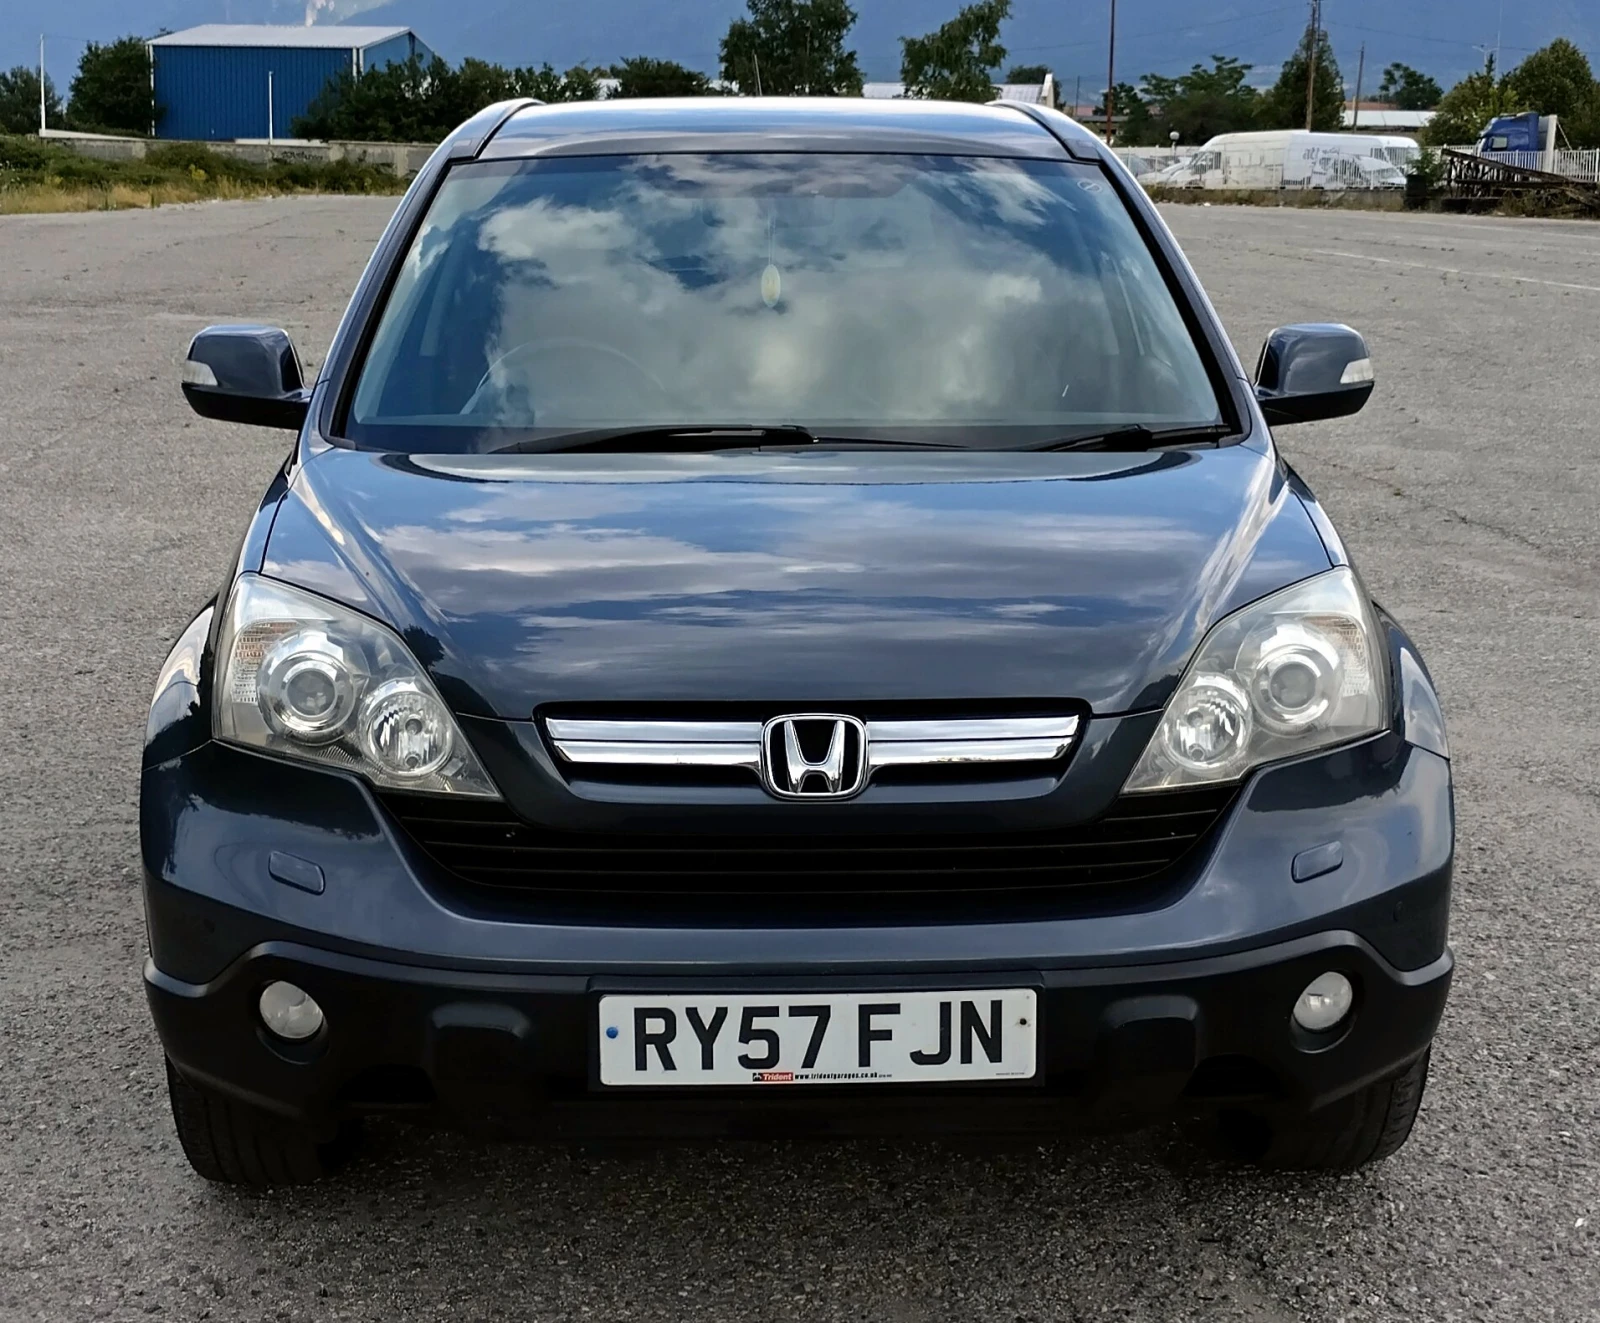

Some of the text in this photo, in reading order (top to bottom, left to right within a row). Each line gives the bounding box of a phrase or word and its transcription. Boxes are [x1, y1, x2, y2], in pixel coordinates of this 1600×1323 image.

[633, 1000, 1003, 1071] RY57 FJN
[763, 1073, 793, 1081] Trident
[795, 1072, 878, 1080] www.tridentgarages.co.uk
